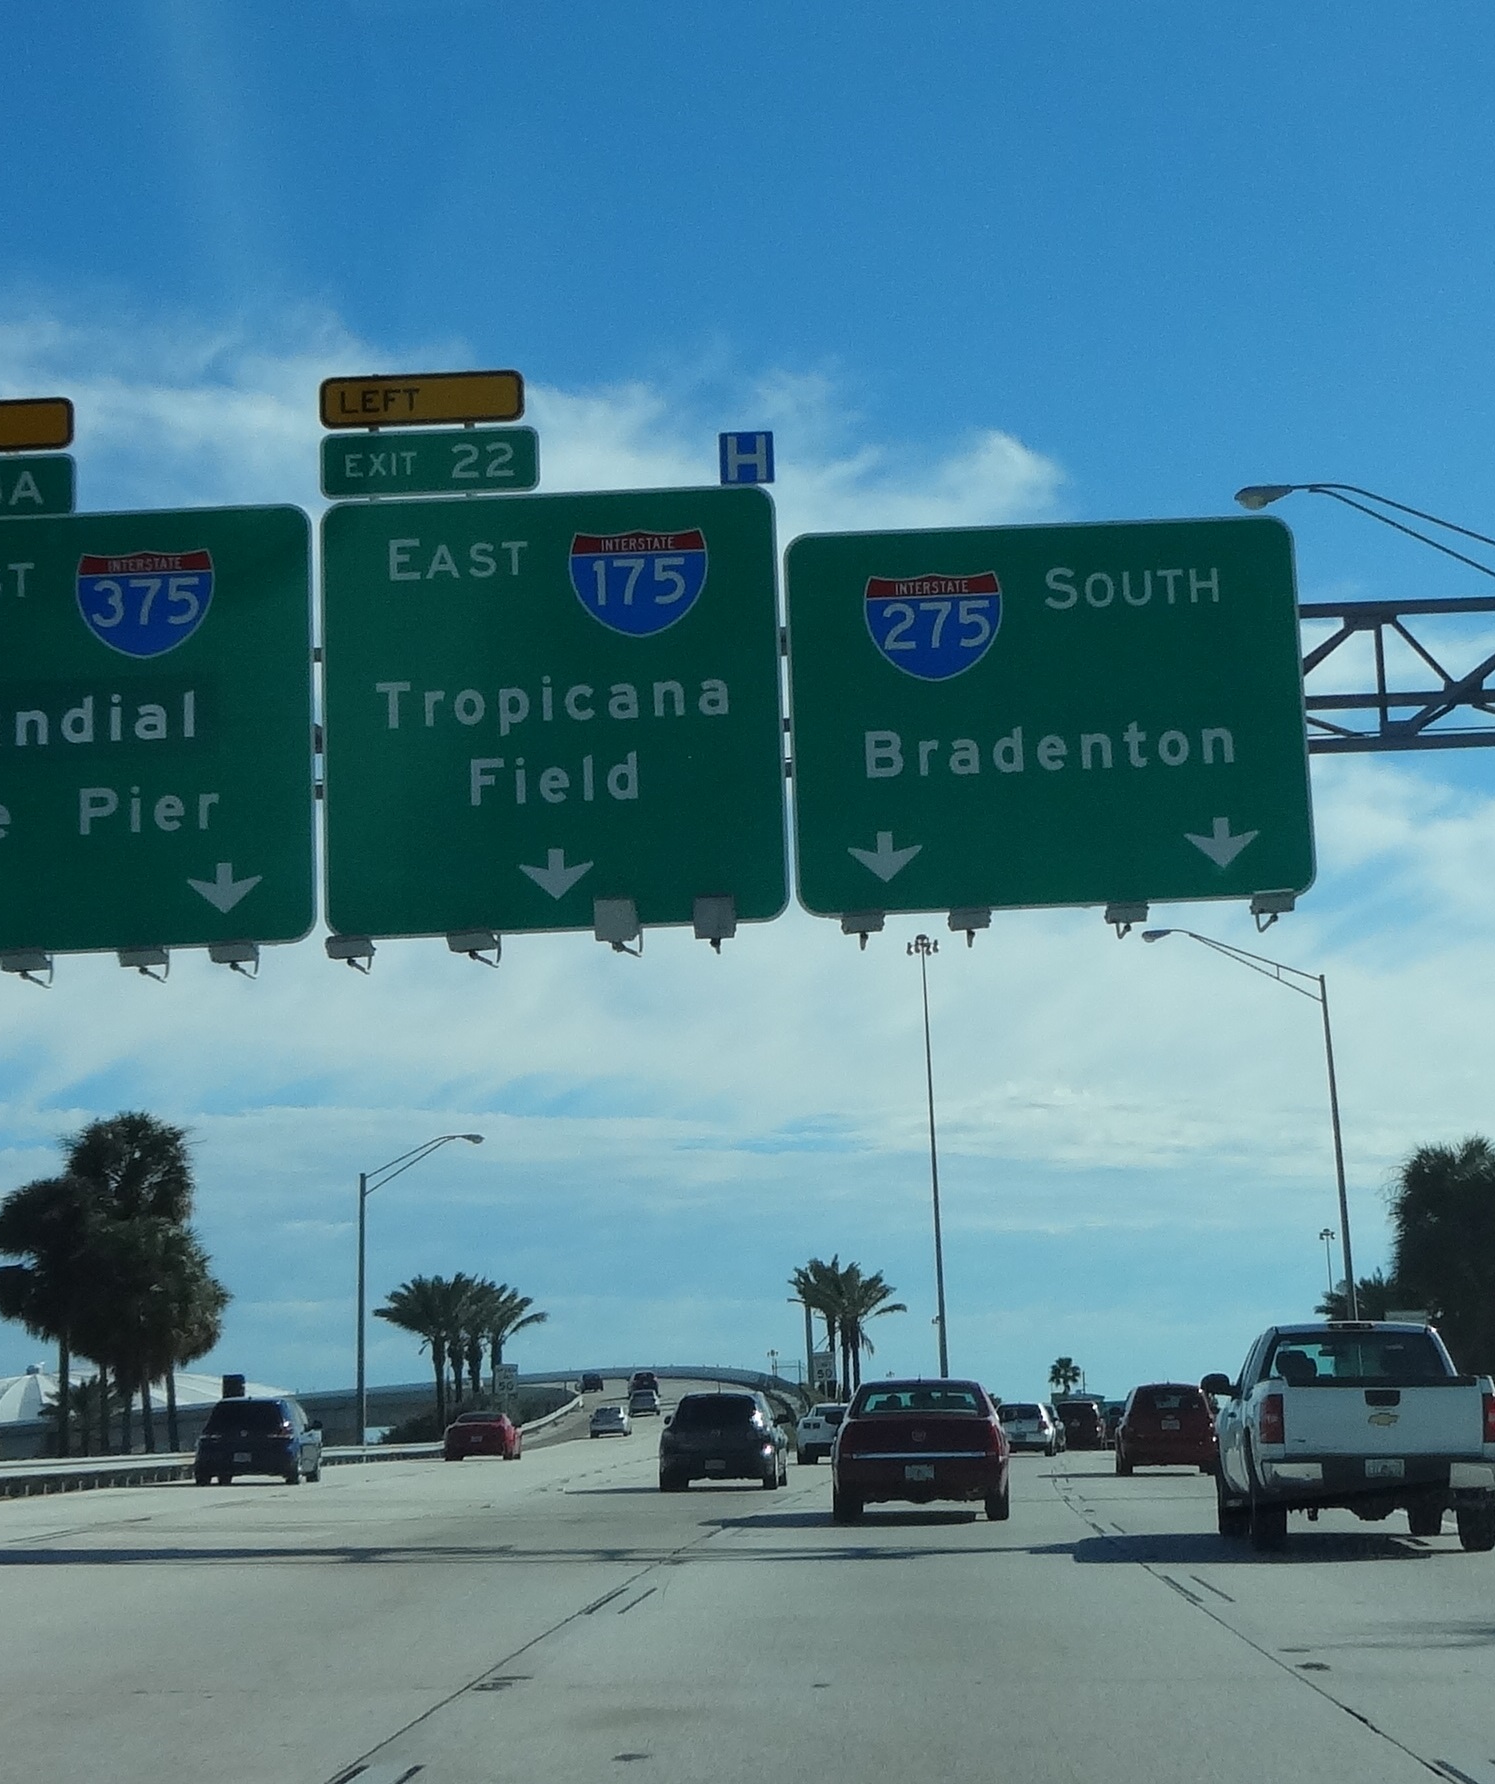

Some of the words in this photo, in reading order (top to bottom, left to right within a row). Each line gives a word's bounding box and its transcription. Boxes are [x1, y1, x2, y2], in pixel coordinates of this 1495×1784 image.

[339, 388, 420, 414] LEFT
[344, 452, 417, 478] EXIT
[450, 443, 515, 479] 22
[726, 434, 767, 482] H
[107, 556, 183, 573] INTERSTATE
[388, 539, 529, 581] EAST
[600, 536, 676, 552] INTERSTATE
[91, 576, 200, 627] 375
[592, 556, 686, 606] 175
[894, 580, 970, 596] INTERSTATE
[1044, 566, 1221, 610] SOUTH
[882, 599, 991, 650] 275
[376, 676, 729, 736] Tropicana
[864, 721, 1235, 779] Bradenton
[470, 751, 639, 806] Field
[79, 785, 220, 836] Pier
[817, 1369, 833, 1379] 50
